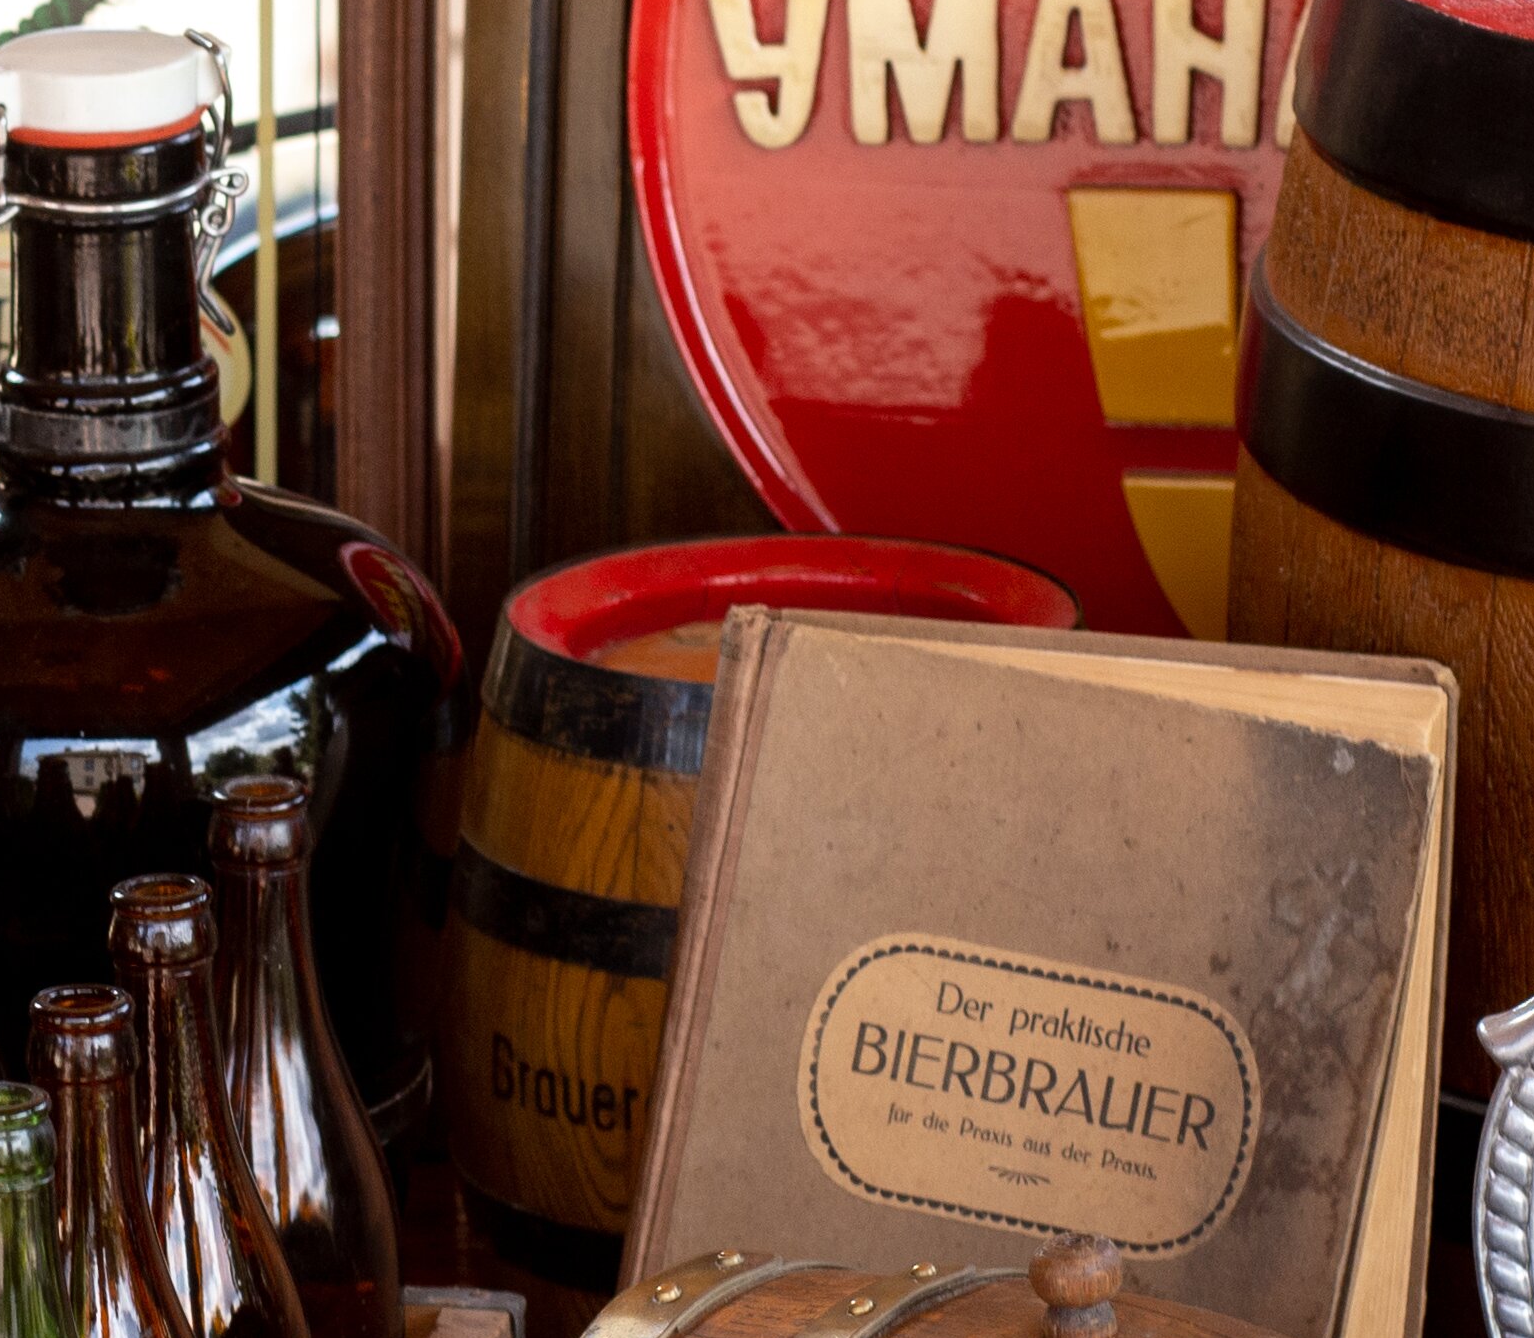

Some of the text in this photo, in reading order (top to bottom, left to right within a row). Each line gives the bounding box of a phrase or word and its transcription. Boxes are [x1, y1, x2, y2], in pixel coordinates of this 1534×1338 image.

[936, 981, 1152, 1059] Der praktische
[491, 1029, 640, 1134] Brauer
[851, 1021, 1216, 1151] BIERBRAUER
[922, 1111, 950, 1134] die
[959, 1117, 1013, 1148] Praxis
[1023, 1134, 1051, 1157] aus
[1061, 1141, 1093, 1165] der
